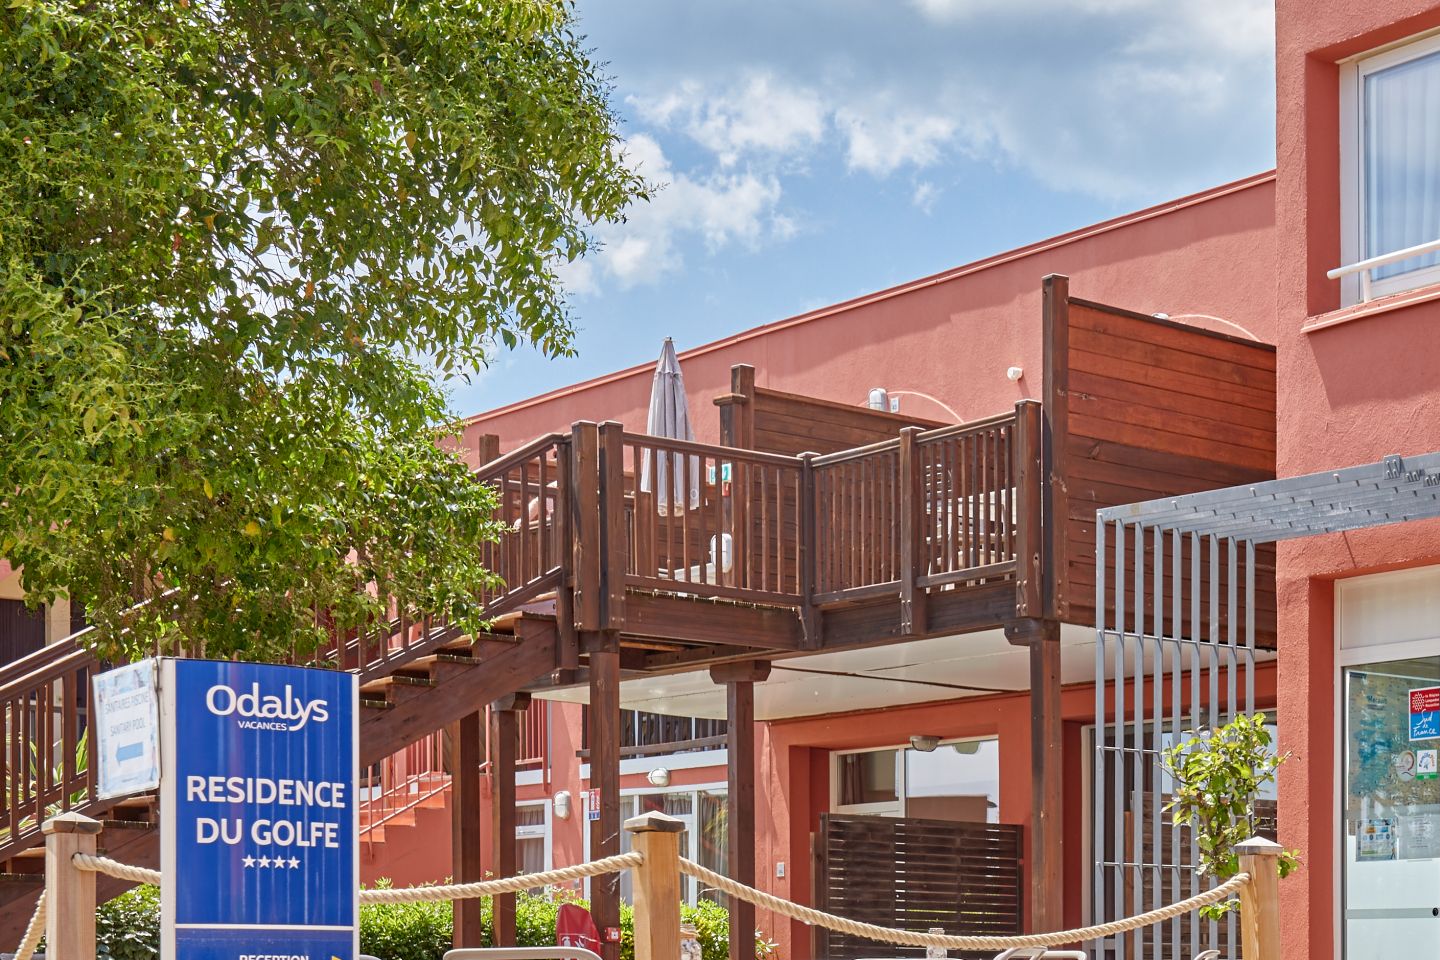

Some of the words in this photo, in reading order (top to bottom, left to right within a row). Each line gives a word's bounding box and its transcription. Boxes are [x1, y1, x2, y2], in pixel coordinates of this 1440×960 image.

[206, 682, 329, 731] Odalys
[237, 720, 288, 731] VACANCES
[187, 776, 346, 808] RESIDENCE
[196, 817, 243, 844] DU
[250, 819, 339, 848] GOLFE
